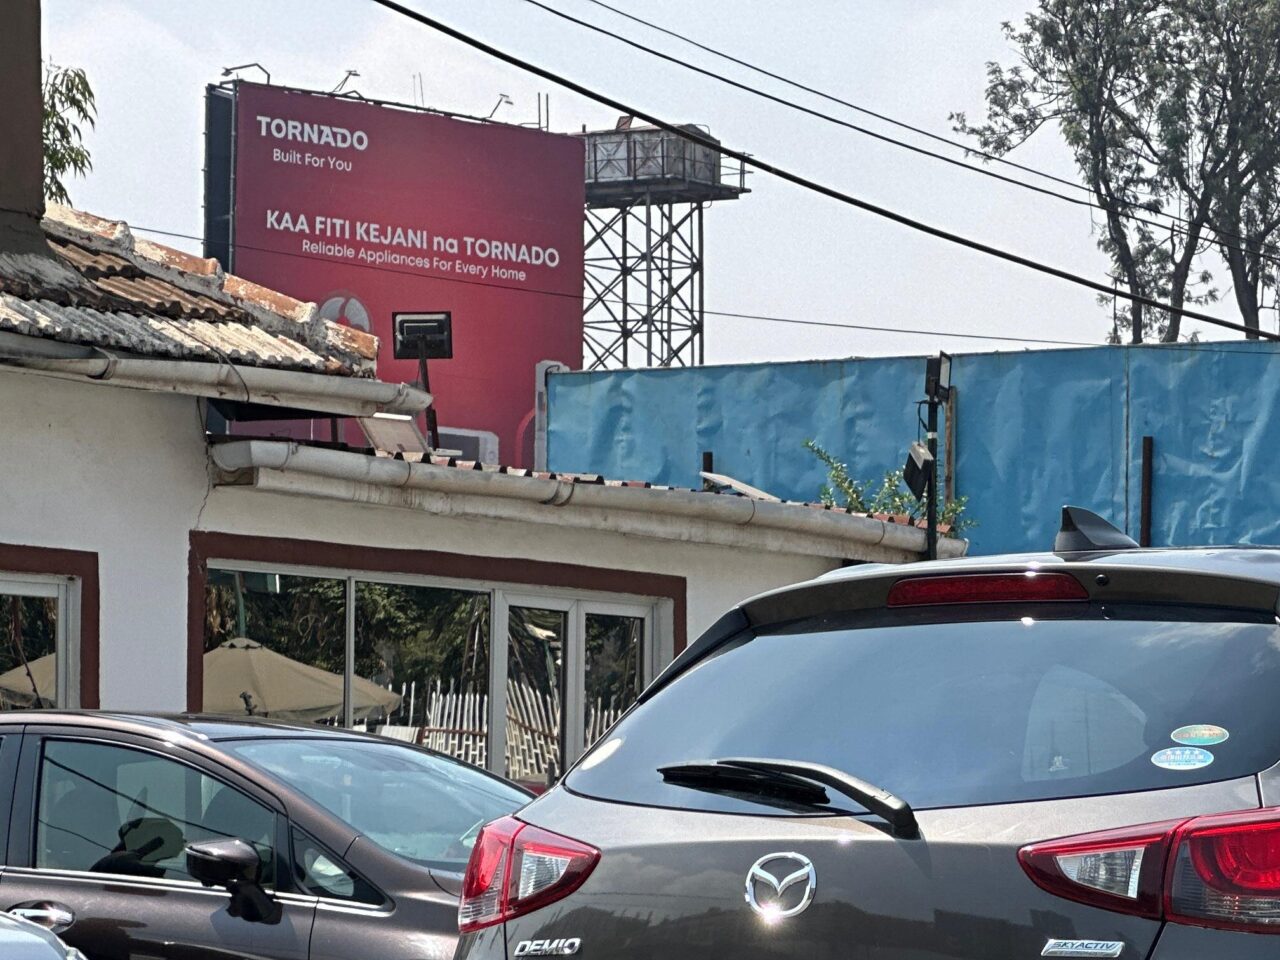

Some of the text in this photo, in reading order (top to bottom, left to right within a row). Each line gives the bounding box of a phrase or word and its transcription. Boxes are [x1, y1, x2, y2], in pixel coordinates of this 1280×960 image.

[256, 115, 369, 151] TORNADO
[273, 148, 352, 172] Built For You
[266, 209, 560, 268] KAA FITI KEJANI na TORNADO
[302, 239, 526, 281] Reliable Appliances For Every Home
[513, 937, 582, 957] DEMIO
[1051, 941, 1117, 950] SKYACTIV
